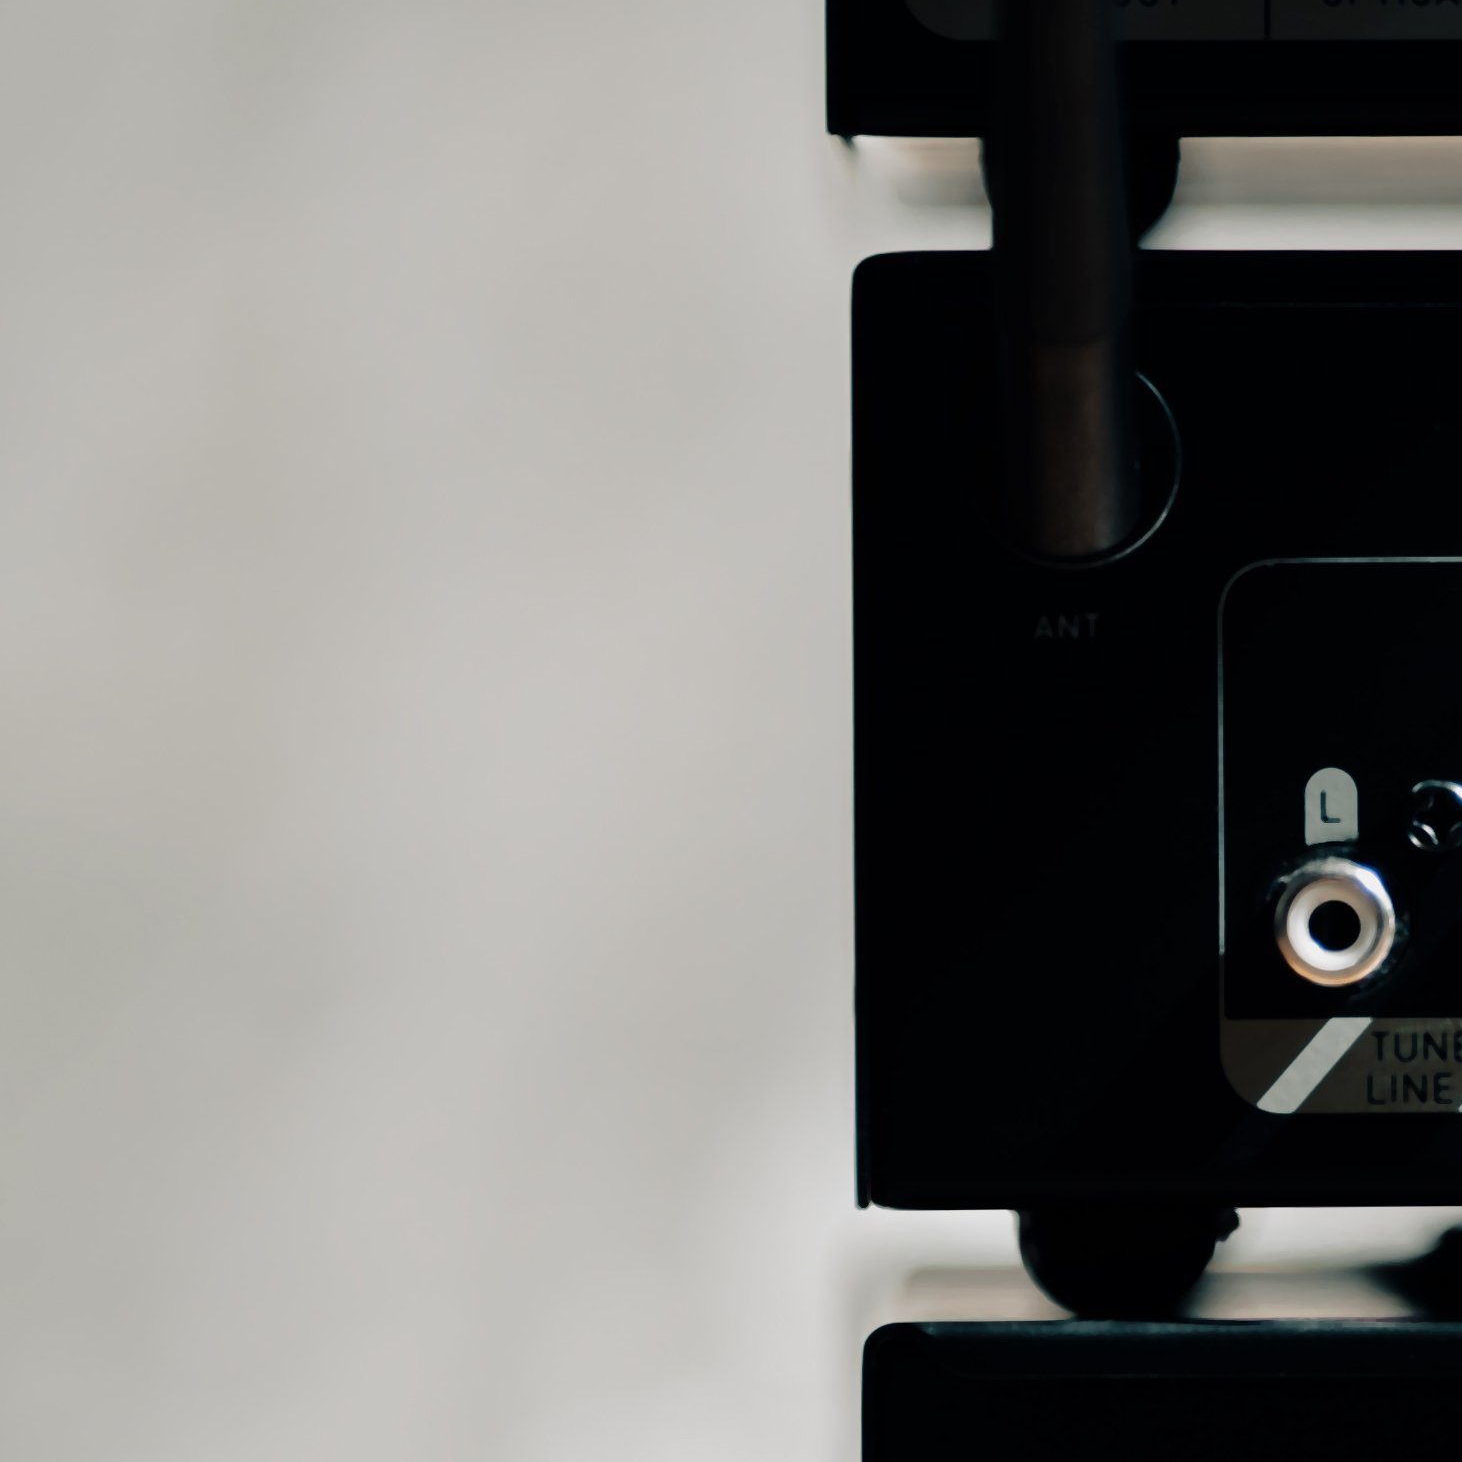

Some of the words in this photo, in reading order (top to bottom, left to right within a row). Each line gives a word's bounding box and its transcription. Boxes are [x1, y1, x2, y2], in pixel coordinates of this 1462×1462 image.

[1034, 614, 1104, 640] ANT
[1320, 790, 1340, 824] L
[1367, 1073, 1453, 1105] LINE
